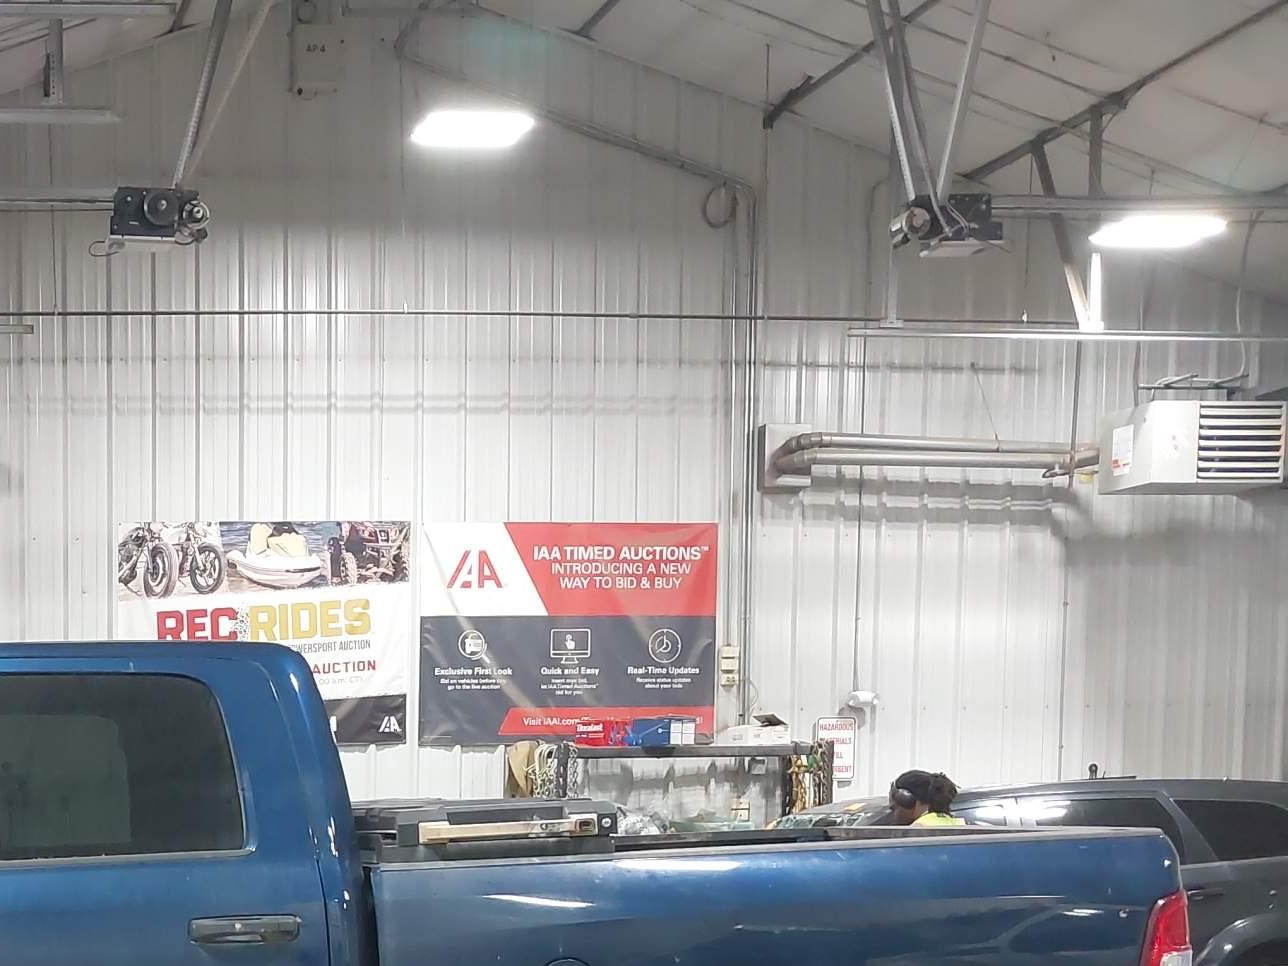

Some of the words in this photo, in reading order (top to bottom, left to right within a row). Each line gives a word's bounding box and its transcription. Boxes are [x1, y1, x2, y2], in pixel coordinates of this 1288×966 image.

[533, 546, 561, 560] IAA
[564, 546, 613, 560] TIMED
[551, 563, 643, 575] INTRODUCING
[646, 563, 657, 575] A
[660, 563, 692, 575] NEW
[560, 577, 591, 589] WAY
[593, 577, 612, 589] TO
[615, 577, 637, 589] BID
[640, 577, 651, 589] &
[654, 577, 682, 589] BUY
[156, 607, 238, 641] REC
[249, 598, 371, 641] RIDES
[339, 639, 371, 651] AUCTION
[312, 660, 376, 675] AUCTION
[434, 667, 472, 676] Exclusive
[474, 667, 491, 676] First
[493, 667, 513, 676] Look
[540, 667, 562, 675] Quick
[564, 667, 579, 675] and
[580, 667, 600, 676] Easy
[627, 666, 667, 674] Real-Time
[668, 666, 700, 676] Updates
[523, 717, 541, 726] Visit
[819, 723, 854, 731] HAZARDOUS
